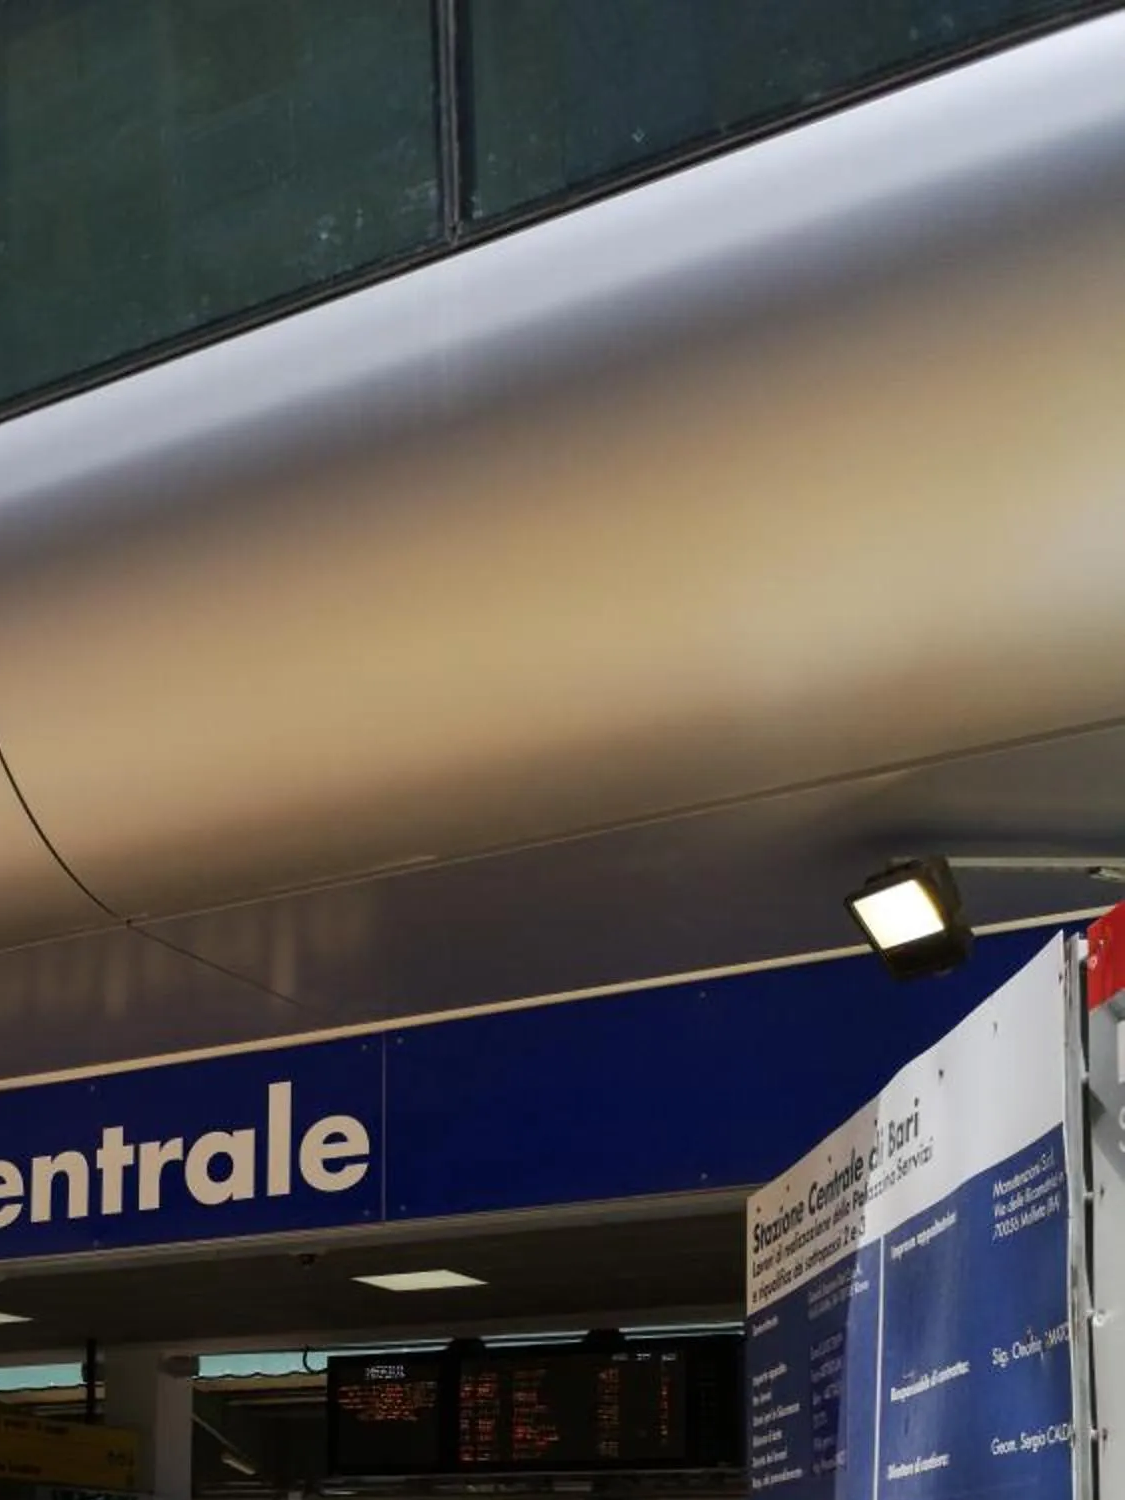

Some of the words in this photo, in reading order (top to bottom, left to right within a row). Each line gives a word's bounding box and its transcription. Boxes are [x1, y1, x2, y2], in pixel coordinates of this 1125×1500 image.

[752, 1201, 805, 1254] Stazione
[807, 1146, 864, 1216] Centrale
[887, 1098, 920, 1158] Bari
[851, 1170, 897, 1212] Palazzina
[896, 1136, 934, 1180] Servizi
